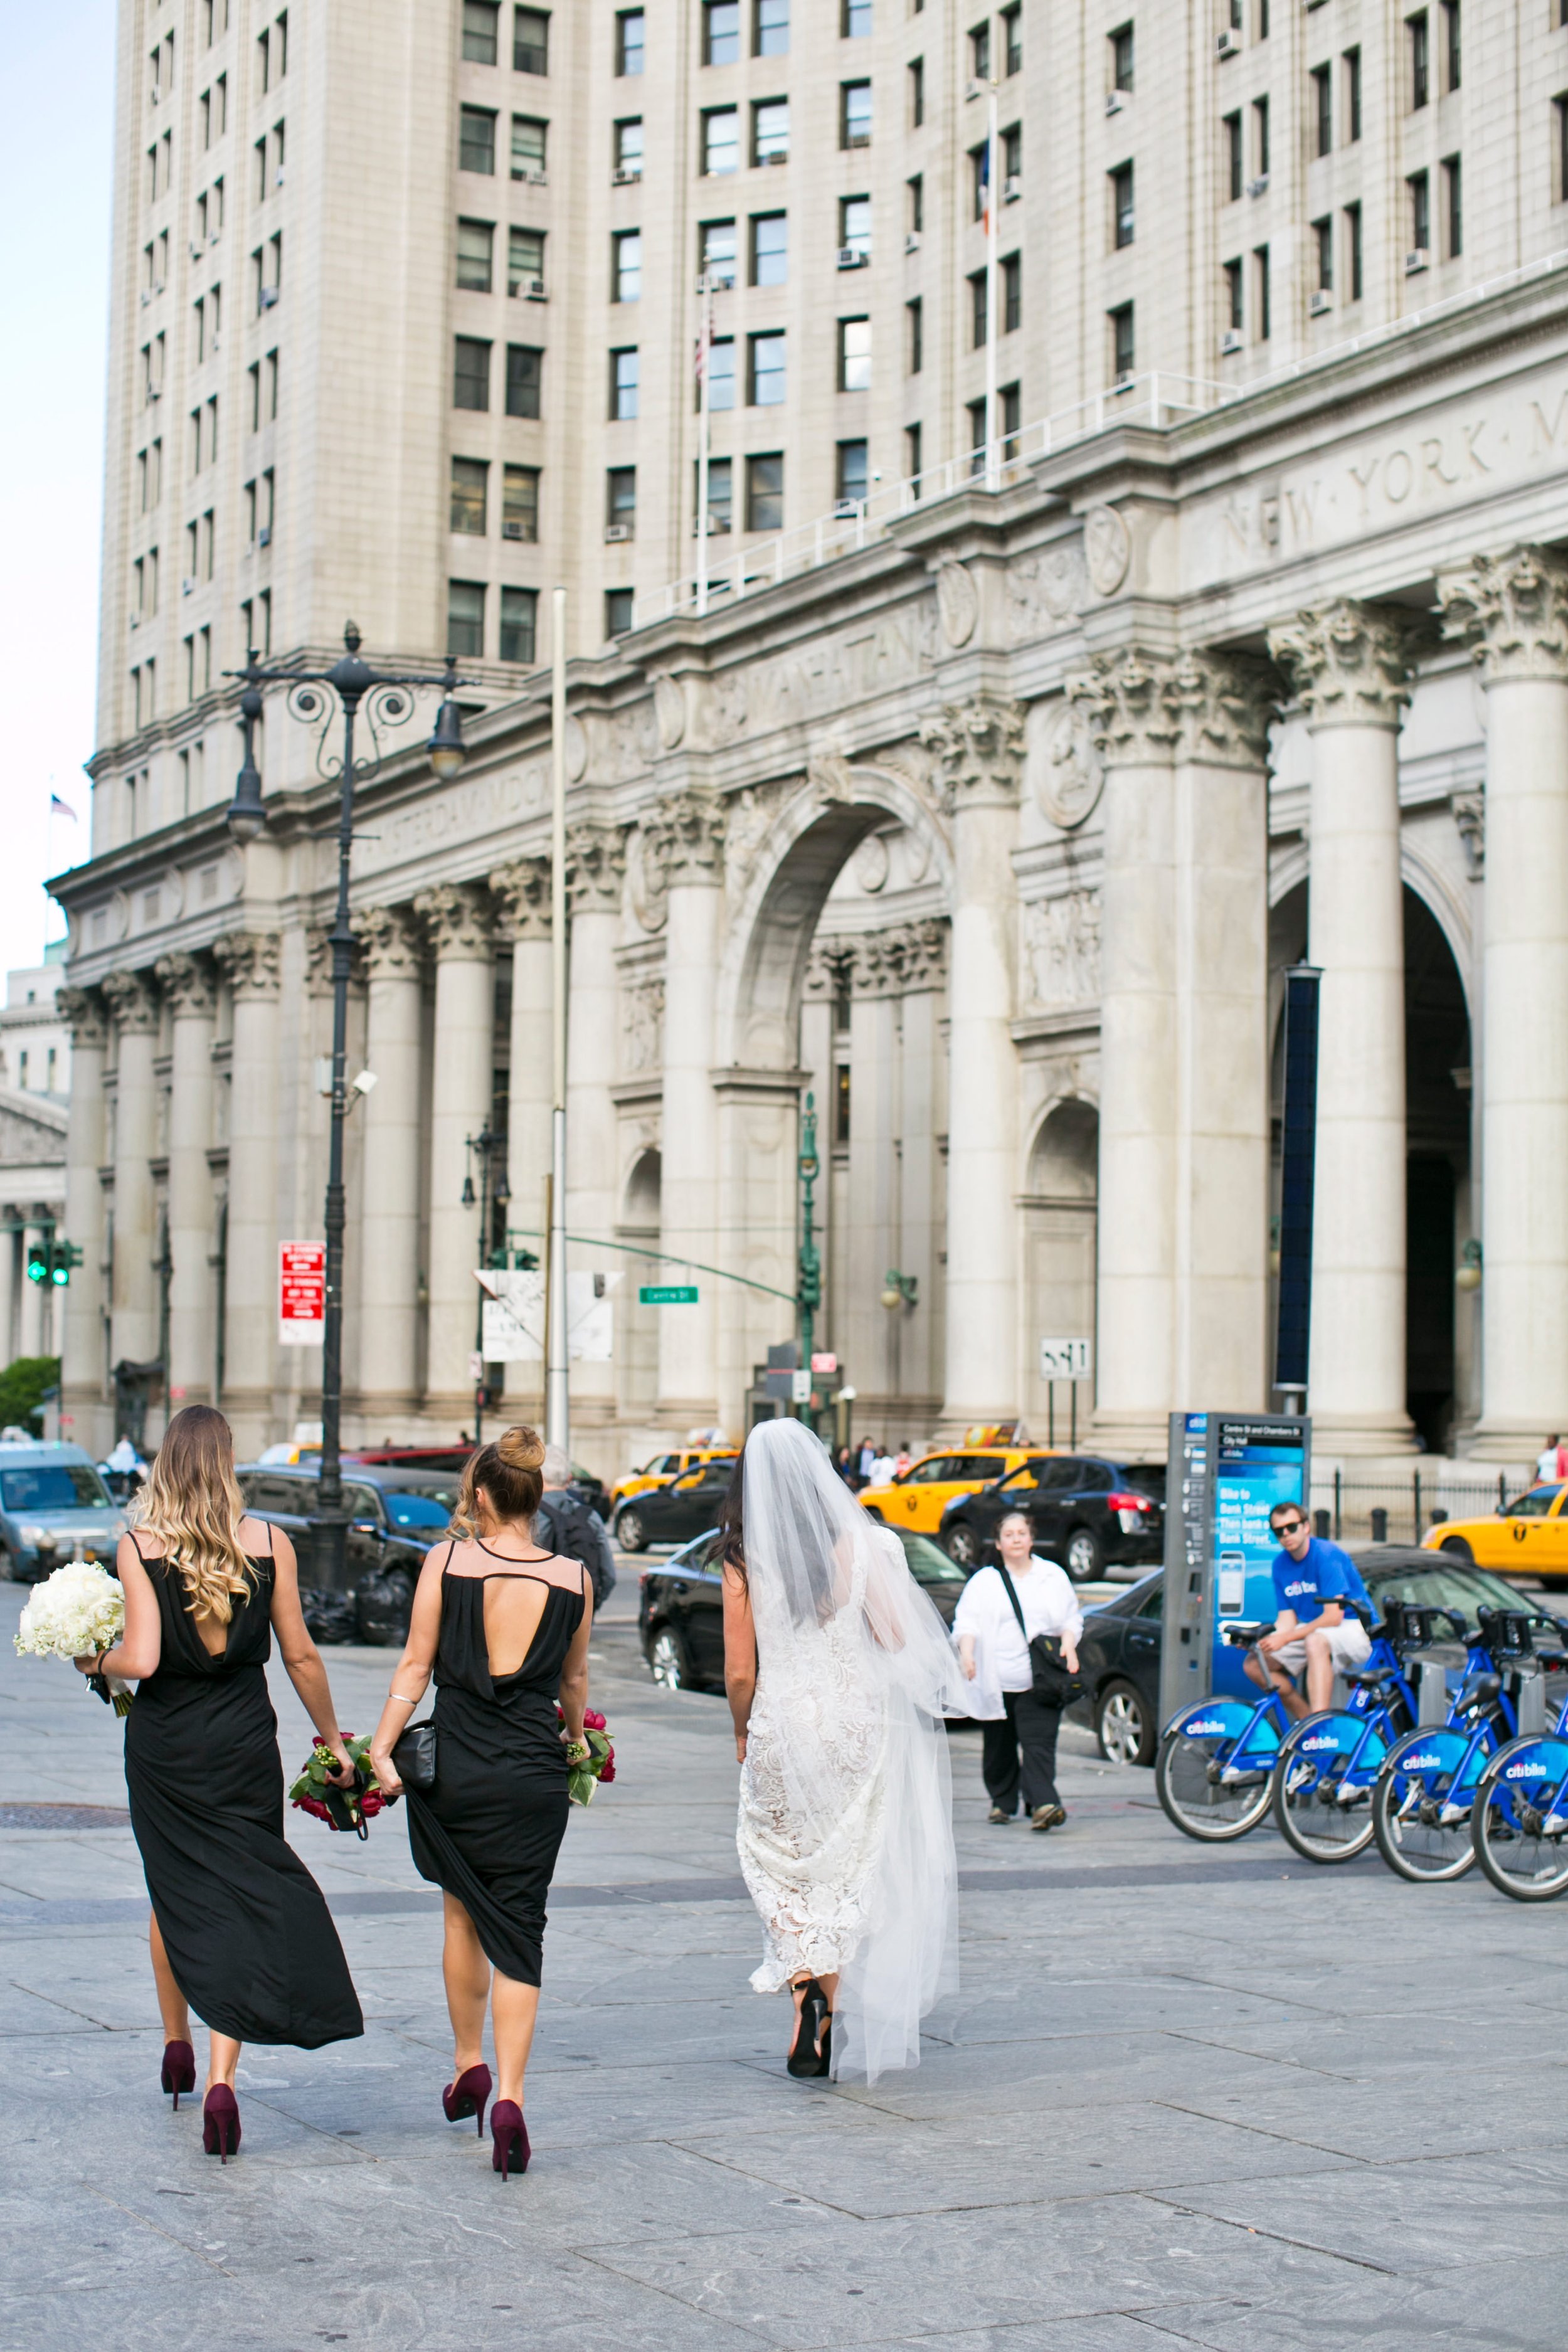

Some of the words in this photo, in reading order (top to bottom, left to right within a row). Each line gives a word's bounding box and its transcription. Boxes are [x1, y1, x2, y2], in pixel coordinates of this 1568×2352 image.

[1348, 420, 1491, 516] YORK
[1251, 1426, 1263, 1434] and
[1220, 1487, 1239, 1500] Bike
[1240, 1488, 1251, 1500] to
[1220, 1502, 1241, 1514] Bank
[1242, 1518, 1262, 1529] bank
[1219, 1532, 1241, 1544] Bank
